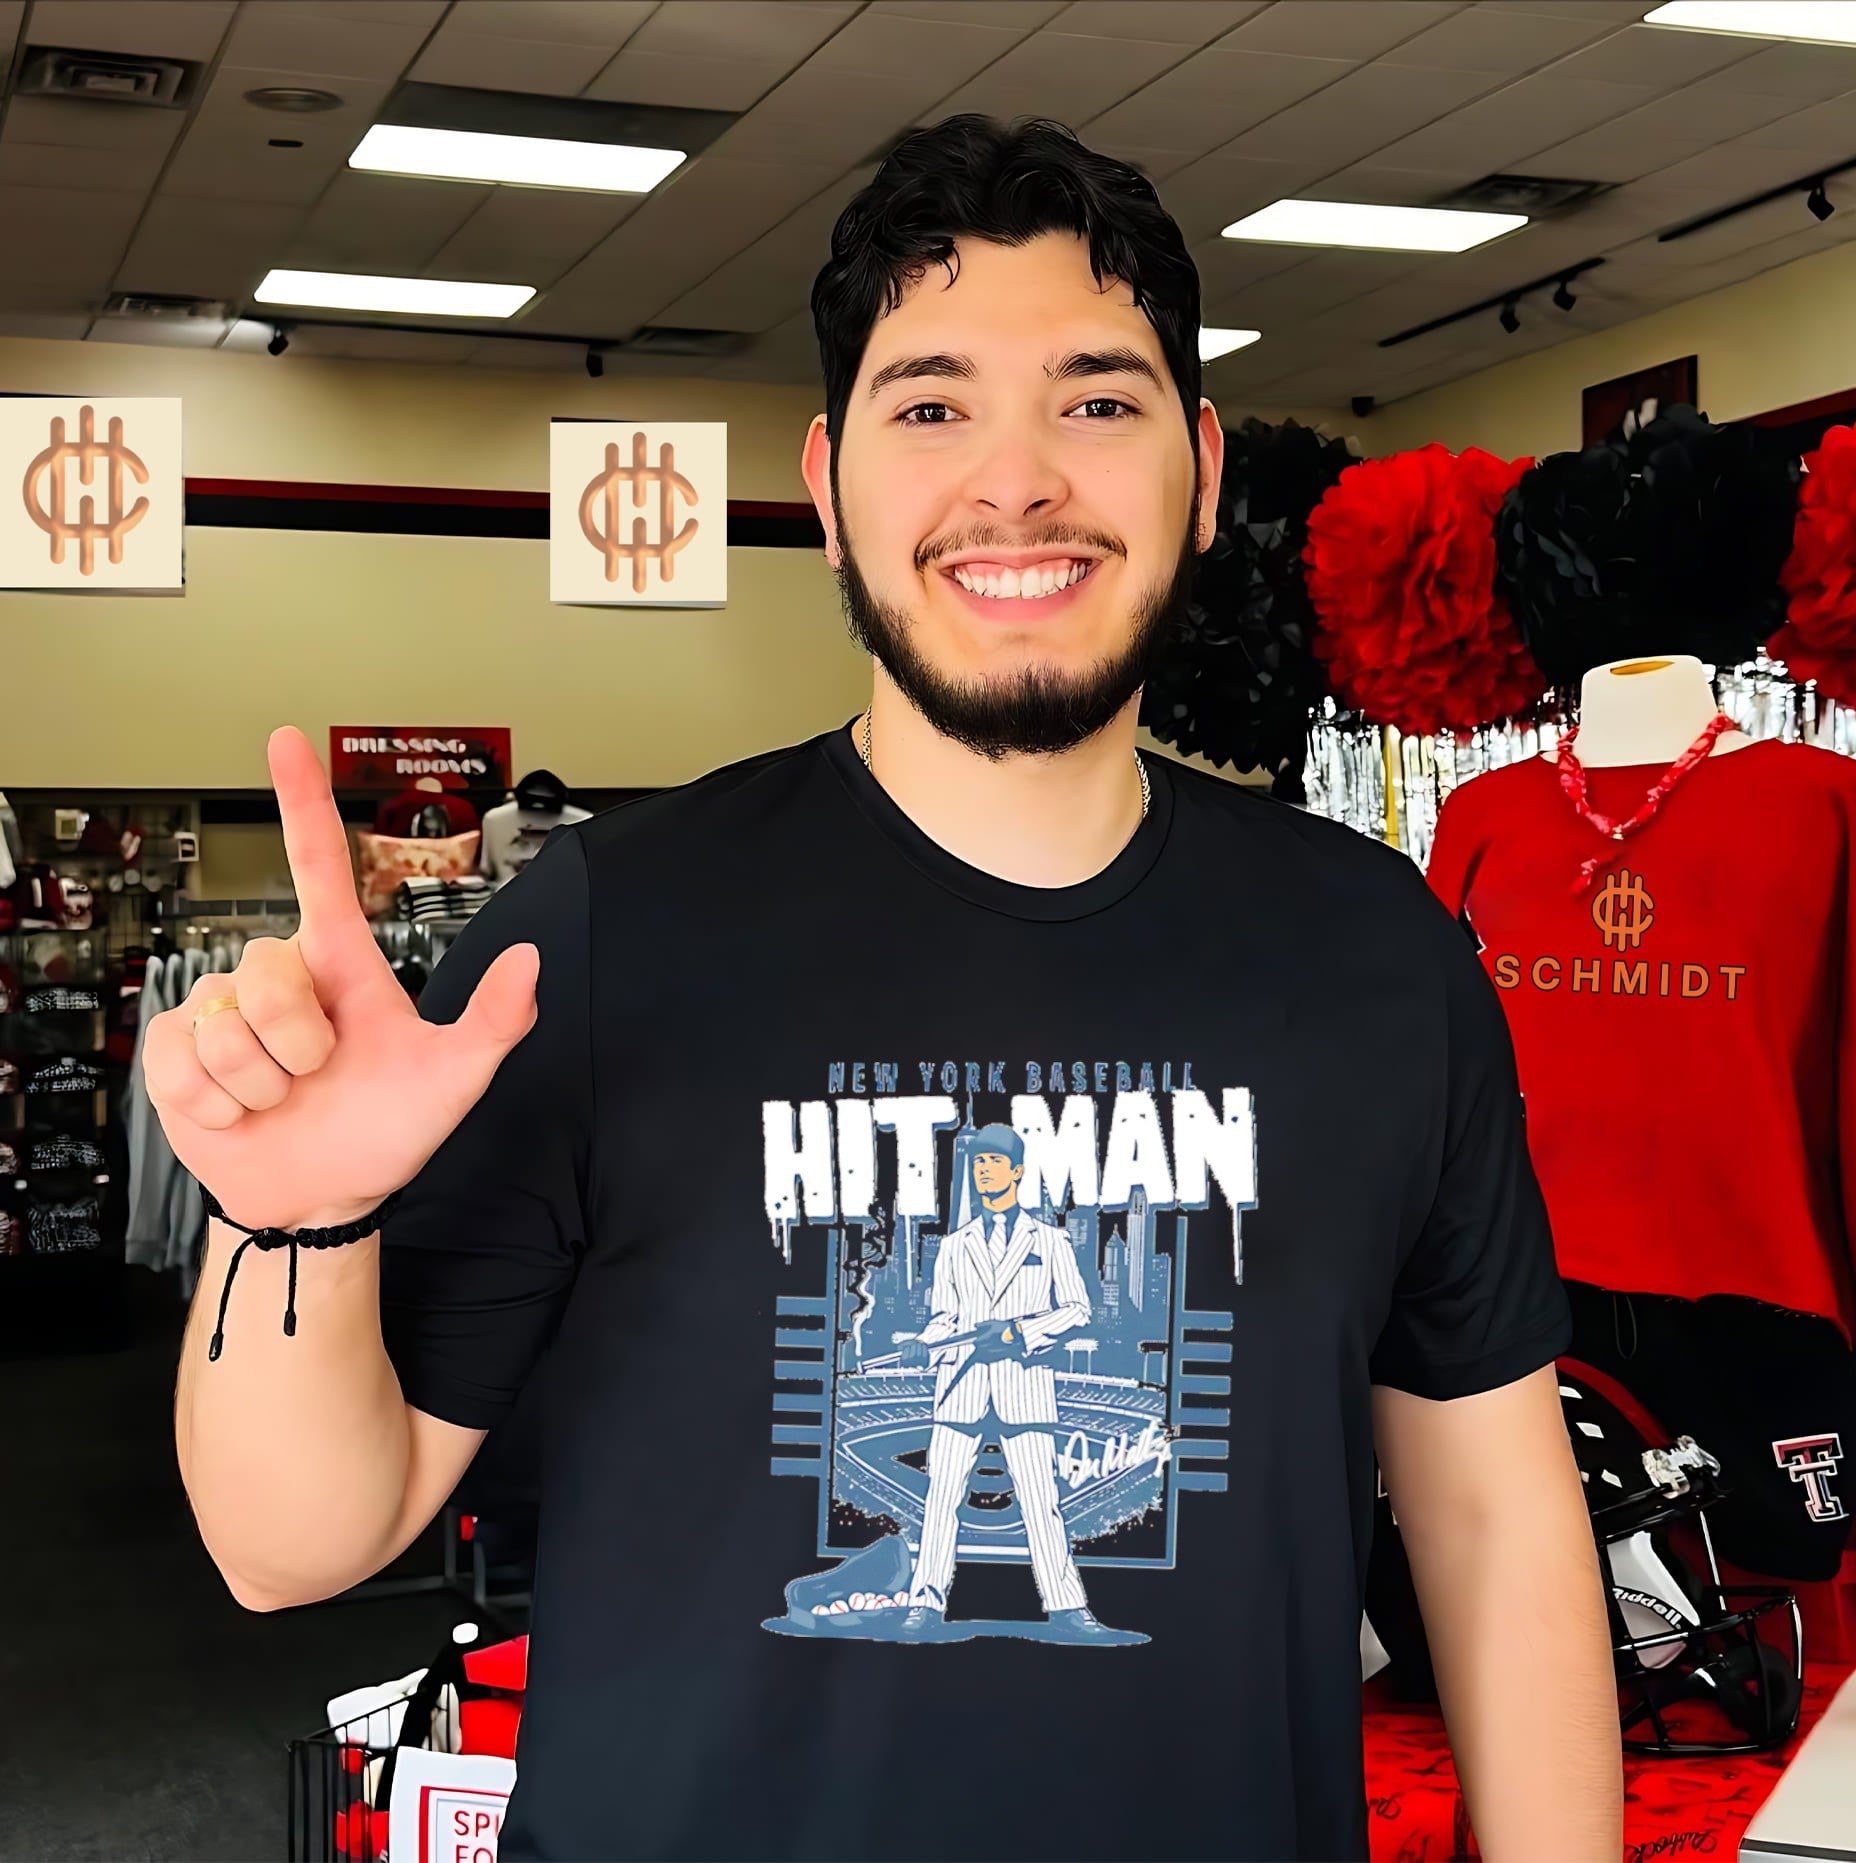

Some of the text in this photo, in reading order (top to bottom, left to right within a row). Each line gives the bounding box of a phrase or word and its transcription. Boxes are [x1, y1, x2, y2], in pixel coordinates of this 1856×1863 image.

[342, 737, 467, 753] DRESSING
[396, 758, 487, 775] ROOMS
[1494, 954, 1747, 1000] SCHMIDT
[828, 1061, 1198, 1093] NEW YORK BASEBALL
[763, 1087, 1259, 1235] HIT MAN
